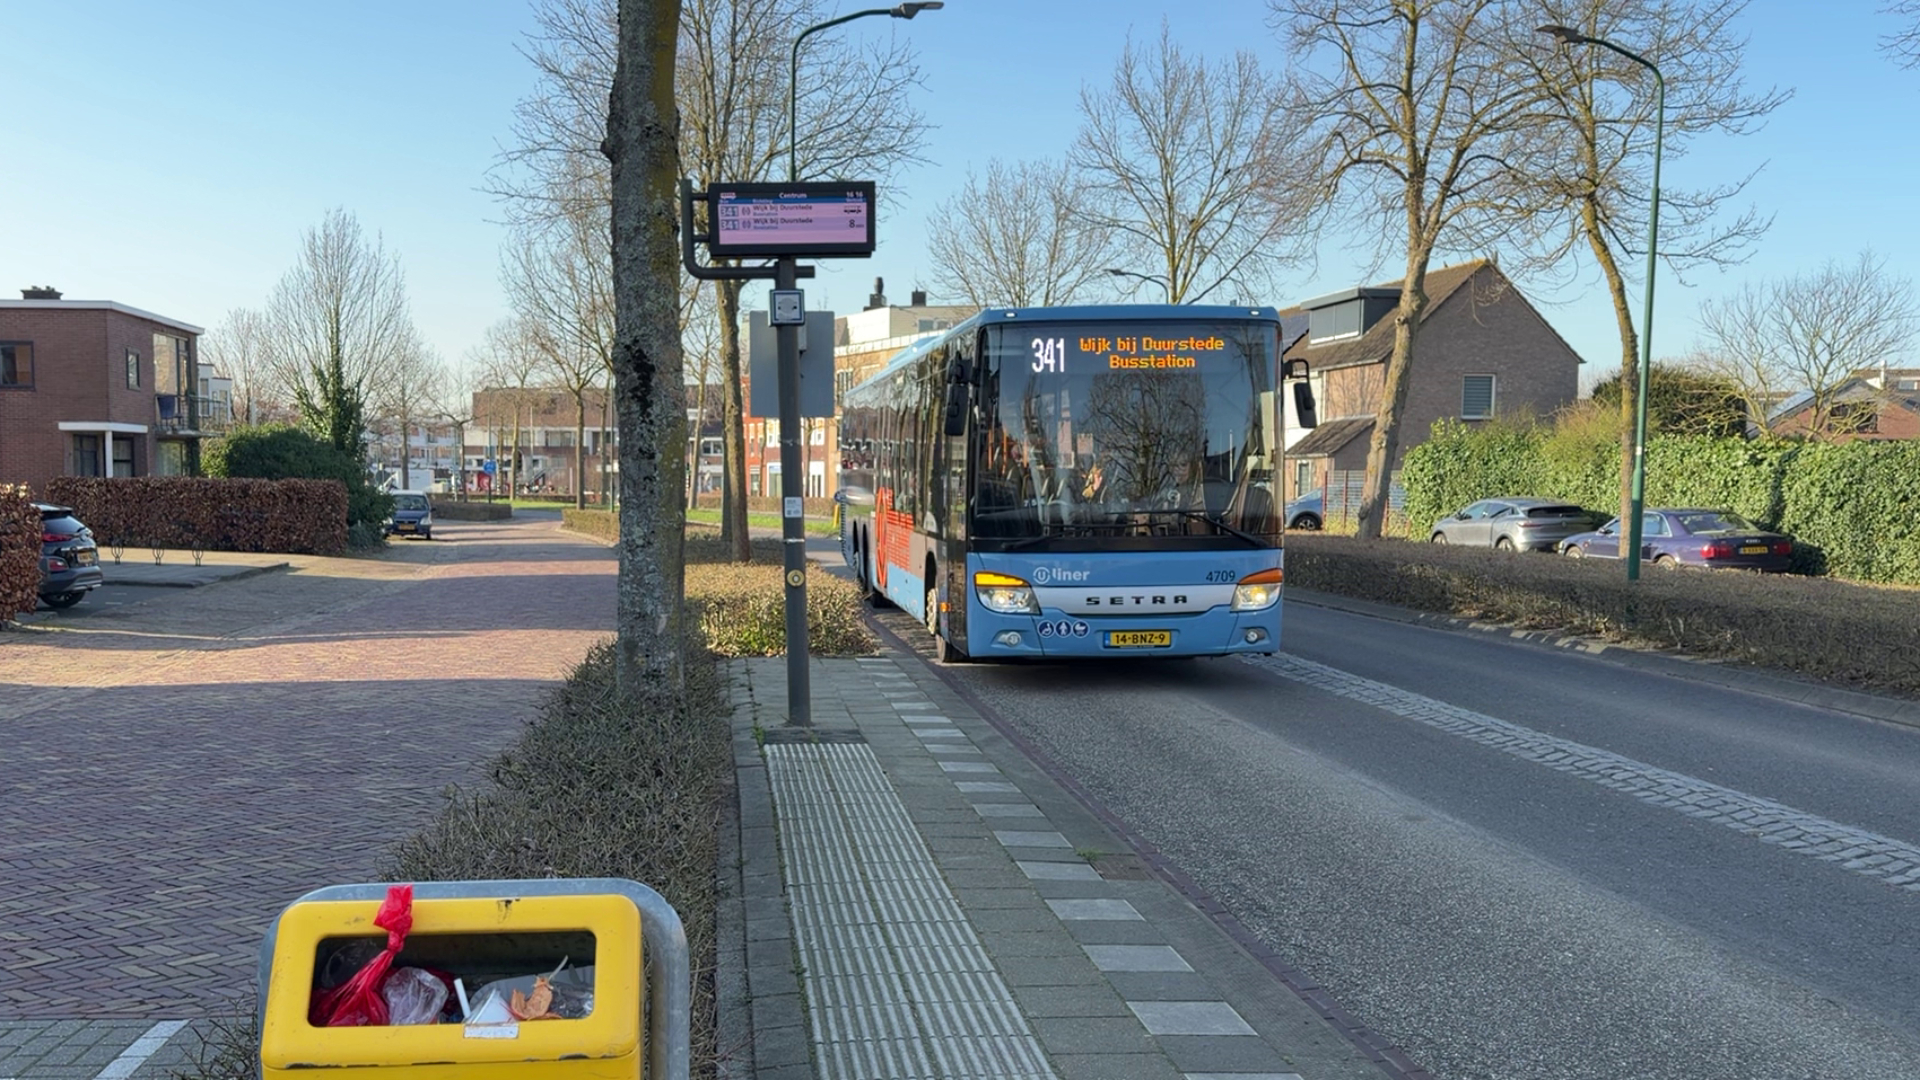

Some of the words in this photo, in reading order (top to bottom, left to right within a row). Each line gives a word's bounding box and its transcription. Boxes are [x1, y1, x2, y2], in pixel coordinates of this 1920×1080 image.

[721, 207, 738, 216] 341
[770, 204, 778, 212] bij
[721, 220, 738, 229] 341
[753, 218, 767, 226] Wijk
[770, 218, 778, 226] bij
[780, 217, 813, 225] Duurstede
[849, 219, 855, 228] 8
[1031, 338, 1065, 373] 341
[1079, 337, 1111, 354] Wijk
[1116, 337, 1138, 354] bij
[1142, 337, 1225, 351] Duurstede
[1109, 354, 1196, 368] Busstation
[1206, 570, 1236, 582] 4709
[1086, 595, 1188, 606] SETRA
[1115, 633, 1166, 645] 14-BNZ-9
